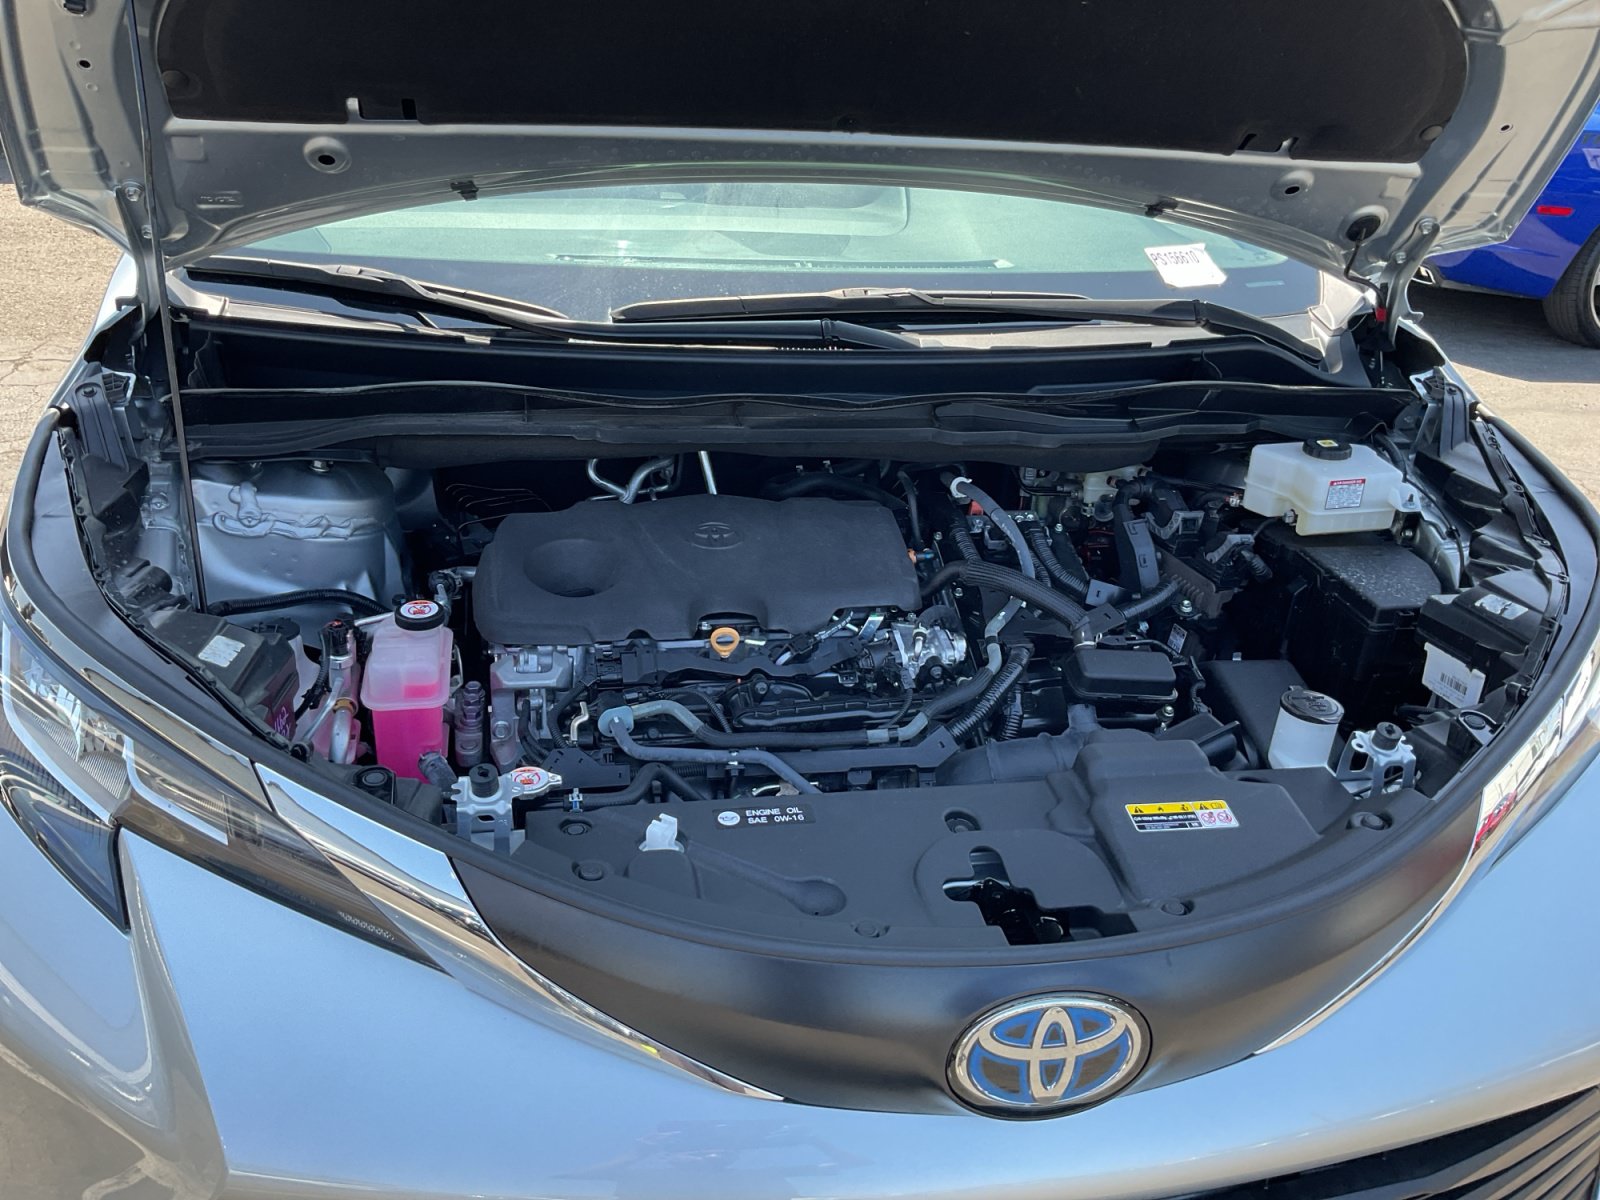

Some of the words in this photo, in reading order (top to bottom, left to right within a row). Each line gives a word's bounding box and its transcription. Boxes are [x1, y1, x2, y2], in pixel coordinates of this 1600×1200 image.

[1150, 250, 1200, 266] PS156610
[745, 808, 781, 817] ENGINE
[748, 816, 768, 824] SAE
[774, 814, 804, 822] 0W-16
